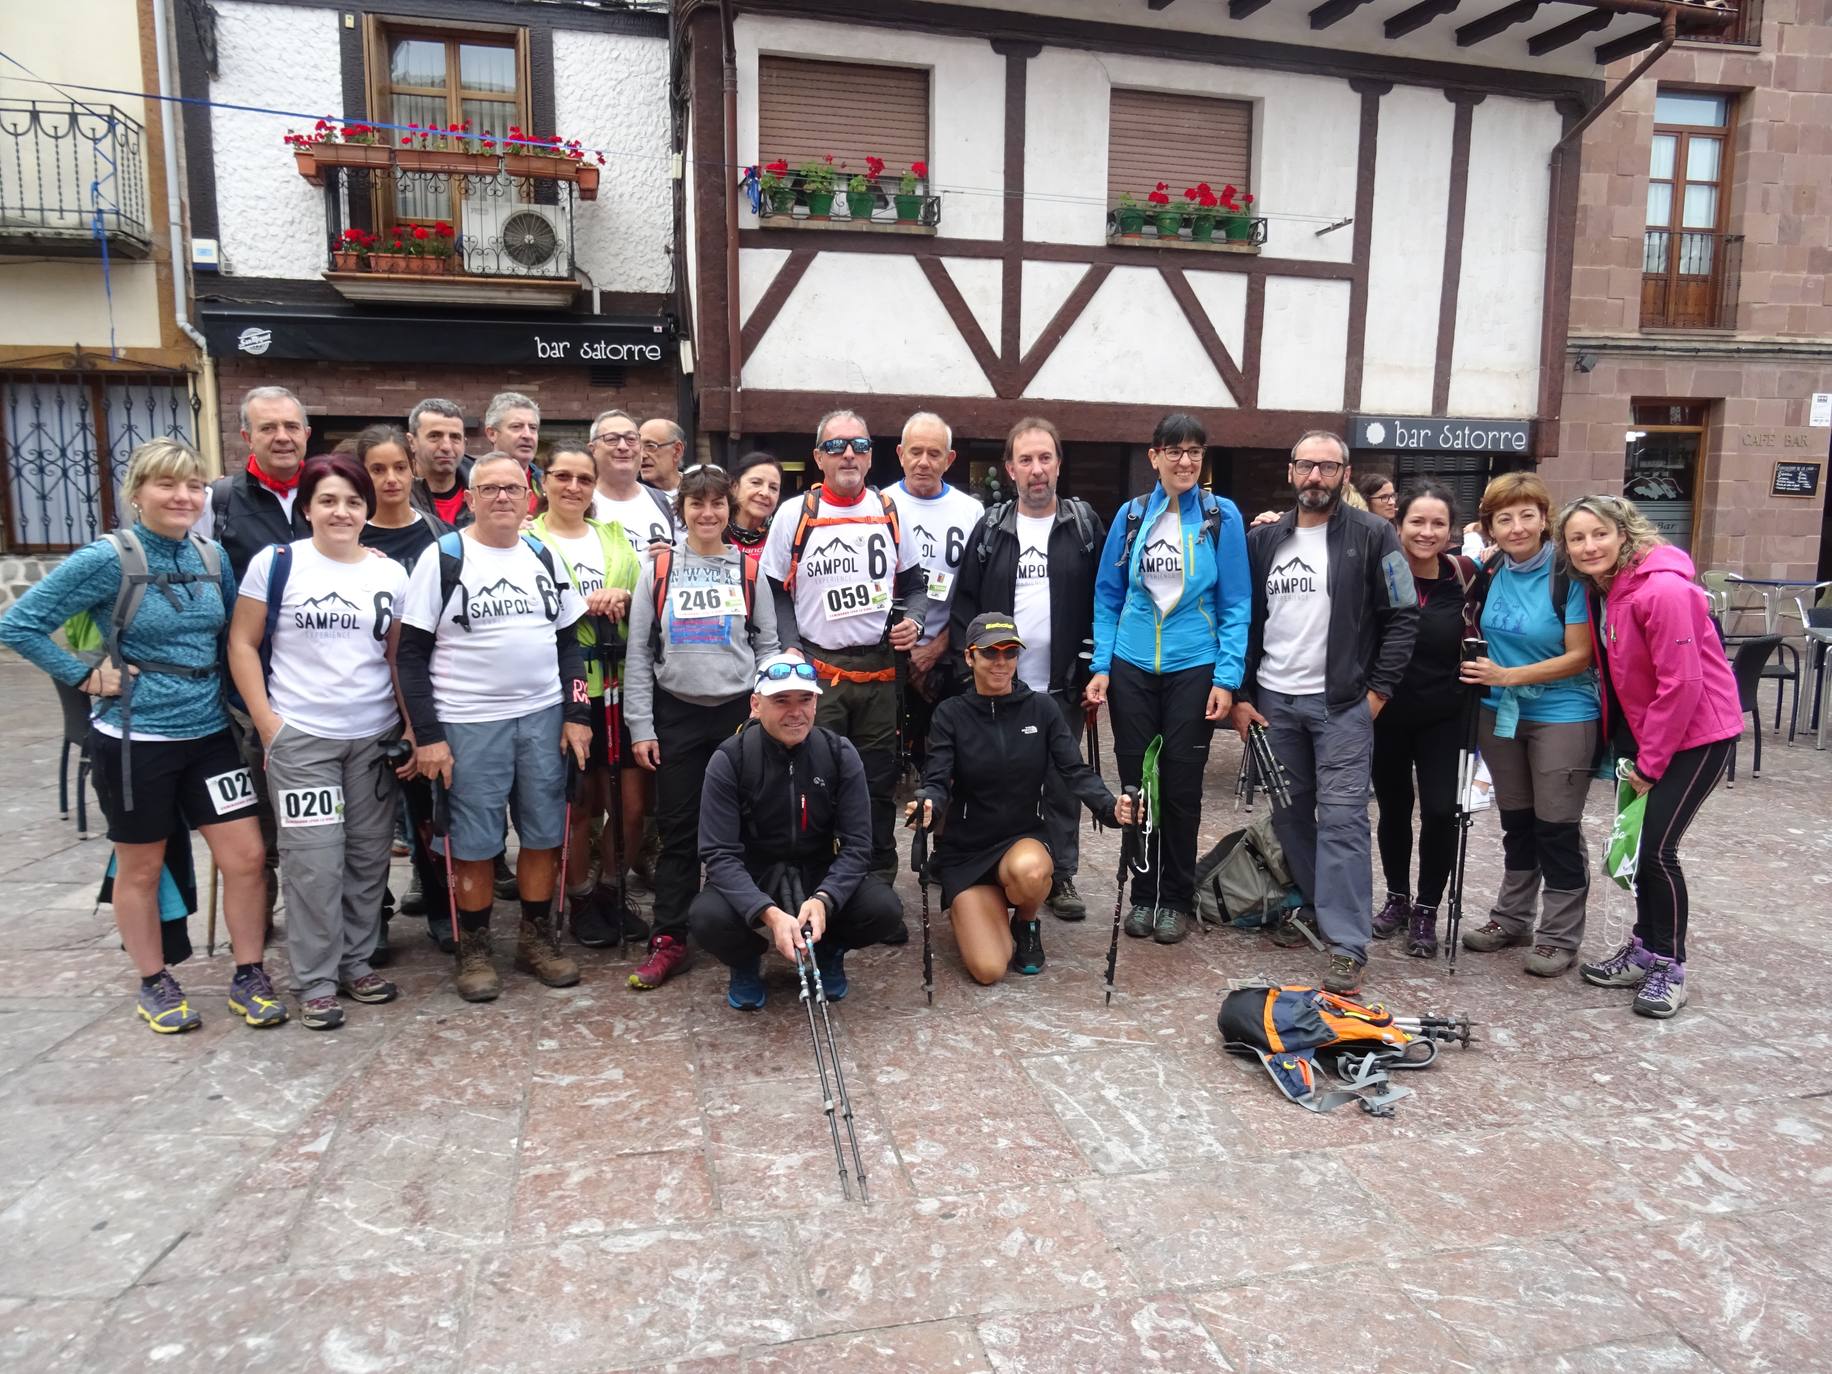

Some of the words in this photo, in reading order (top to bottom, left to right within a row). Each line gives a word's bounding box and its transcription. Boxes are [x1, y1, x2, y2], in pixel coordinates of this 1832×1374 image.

[534, 336, 570, 358] bar
[1394, 420, 1431, 448] bar
[1784, 433, 1808, 448] BAR
[868, 533, 887, 580] 6
[945, 526, 964, 568] 6
[806, 557, 859, 577] SAMPOL
[1018, 564, 1045, 579] MPO
[1138, 557, 1182, 572] AMPOL
[1267, 577, 1316, 595] SAMPOL
[470, 600, 533, 618] SAMPOL
[678, 589, 721, 611] 246
[827, 584, 870, 612] 059
[295, 612, 360, 629] SAMPOL
[373, 591, 393, 641] 6
[217, 772, 251, 802] 02
[285, 790, 332, 818] 020
